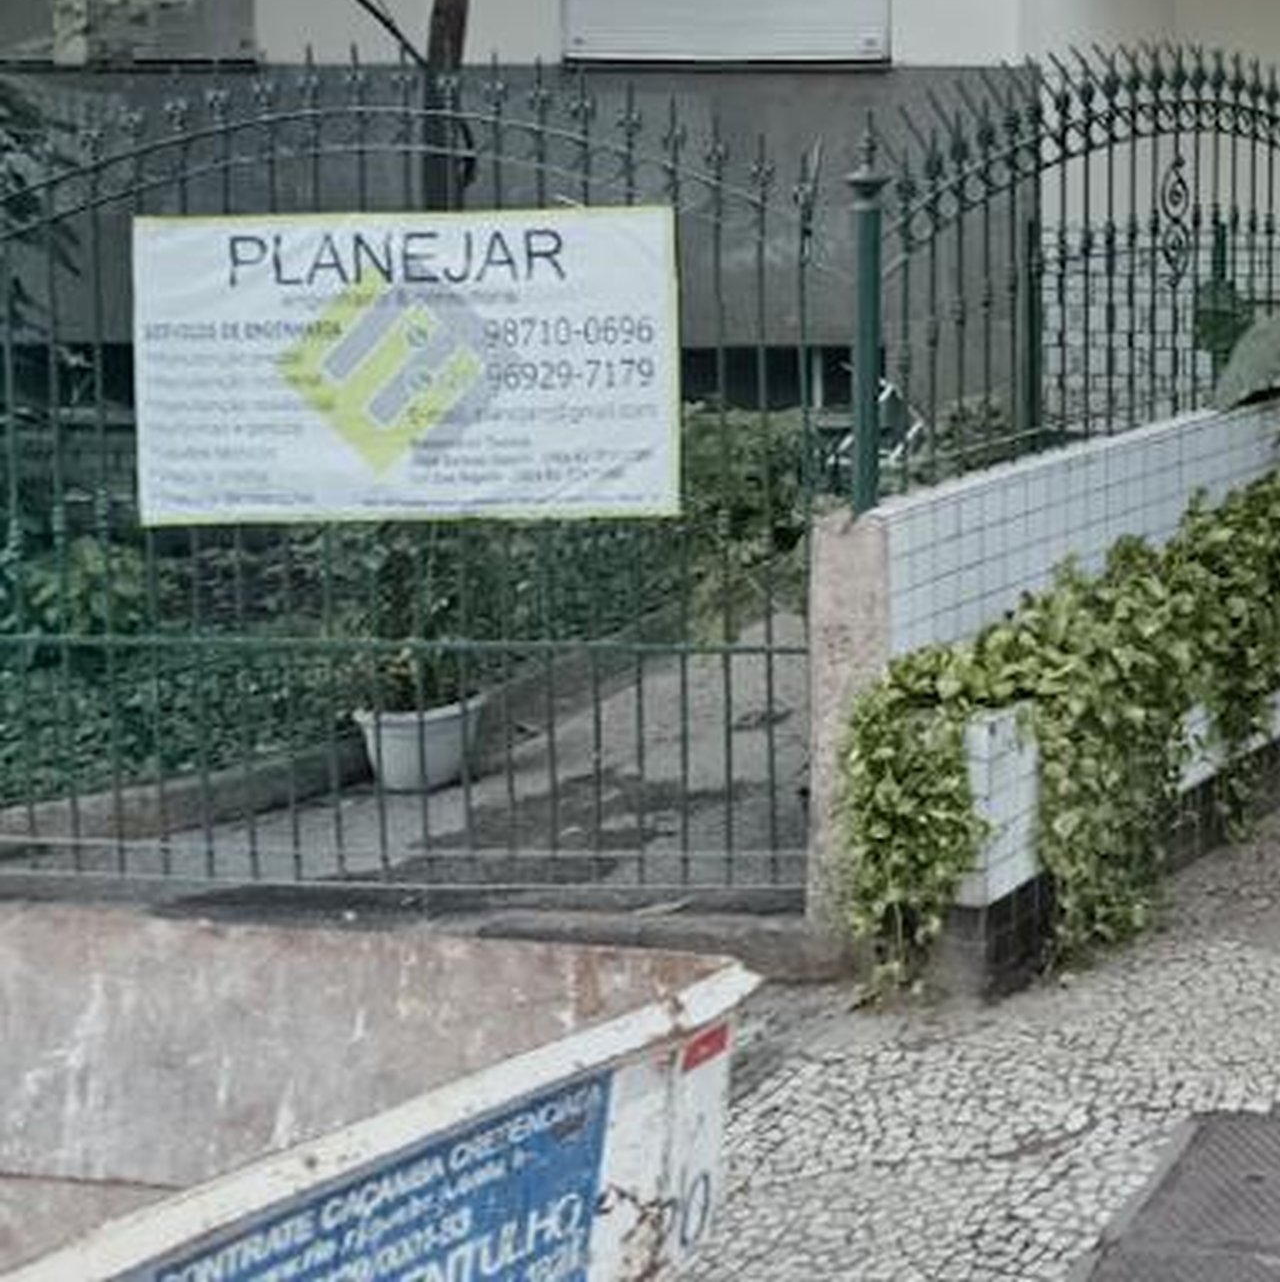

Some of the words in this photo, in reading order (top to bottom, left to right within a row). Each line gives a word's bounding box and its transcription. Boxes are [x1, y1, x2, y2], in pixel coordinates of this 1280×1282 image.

[228, 227, 567, 287] PLANEJAR
[483, 315, 656, 349] 98710-0696
[485, 355, 656, 391] 96929-7179
